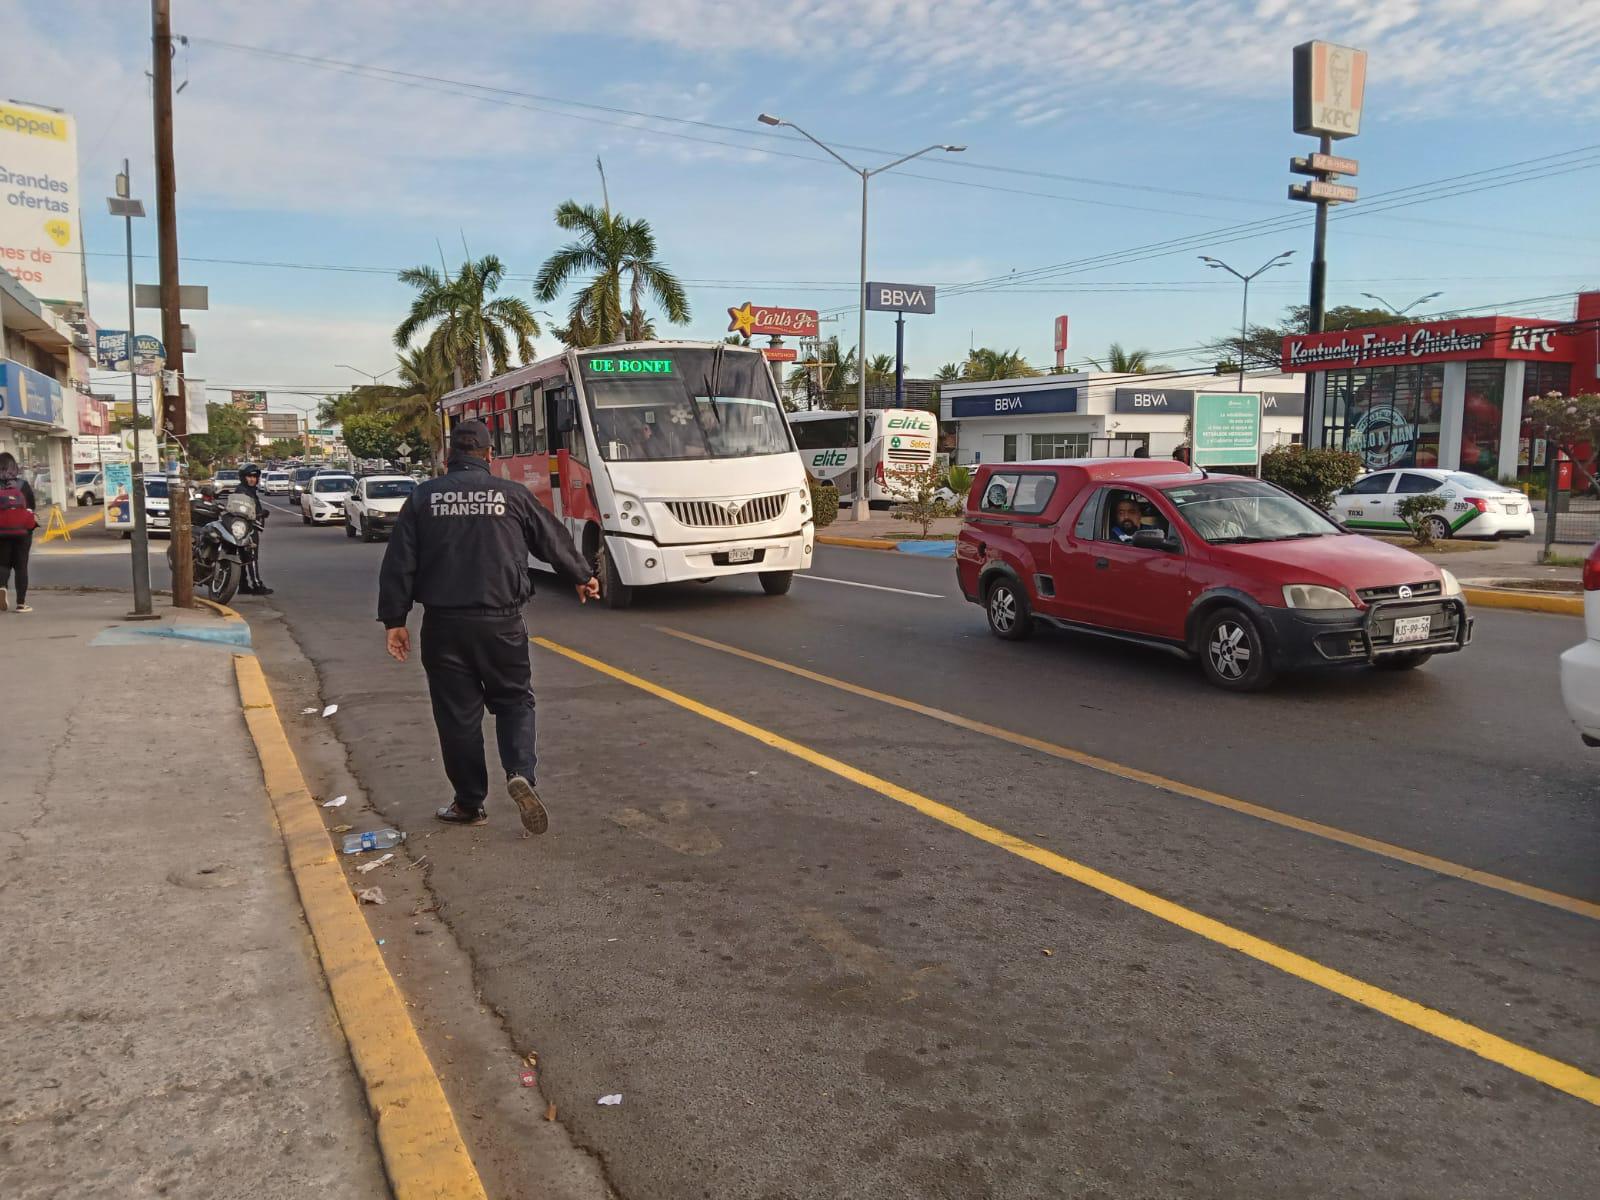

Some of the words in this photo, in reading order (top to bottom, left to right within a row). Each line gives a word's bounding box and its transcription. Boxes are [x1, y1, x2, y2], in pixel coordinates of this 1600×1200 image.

[0, 109, 57, 136] oppel
[1320, 108, 1353, 128] KFC
[7, 190, 69, 213] ofertas
[31, 247, 52, 264] de
[880, 288, 926, 307] BBVA
[754, 309, 792, 327] Carl's
[793, 311, 815, 329] Jr.
[1290, 338, 1359, 366] Kentucky
[1362, 333, 1407, 360] Fried
[1410, 328, 1482, 358] Chicken
[1511, 325, 1557, 353] KFC
[589, 359, 615, 372] UE
[618, 359, 673, 373] BONFI
[994, 396, 1023, 411] BBVA
[1133, 393, 1168, 408] BBVA
[1262, 396, 1277, 409] VA
[887, 416, 931, 430] elite
[909, 440, 931, 449] Select
[812, 450, 848, 467] elite
[430, 489, 506, 504] POLICÍA
[430, 503, 505, 516] TRANSITO
